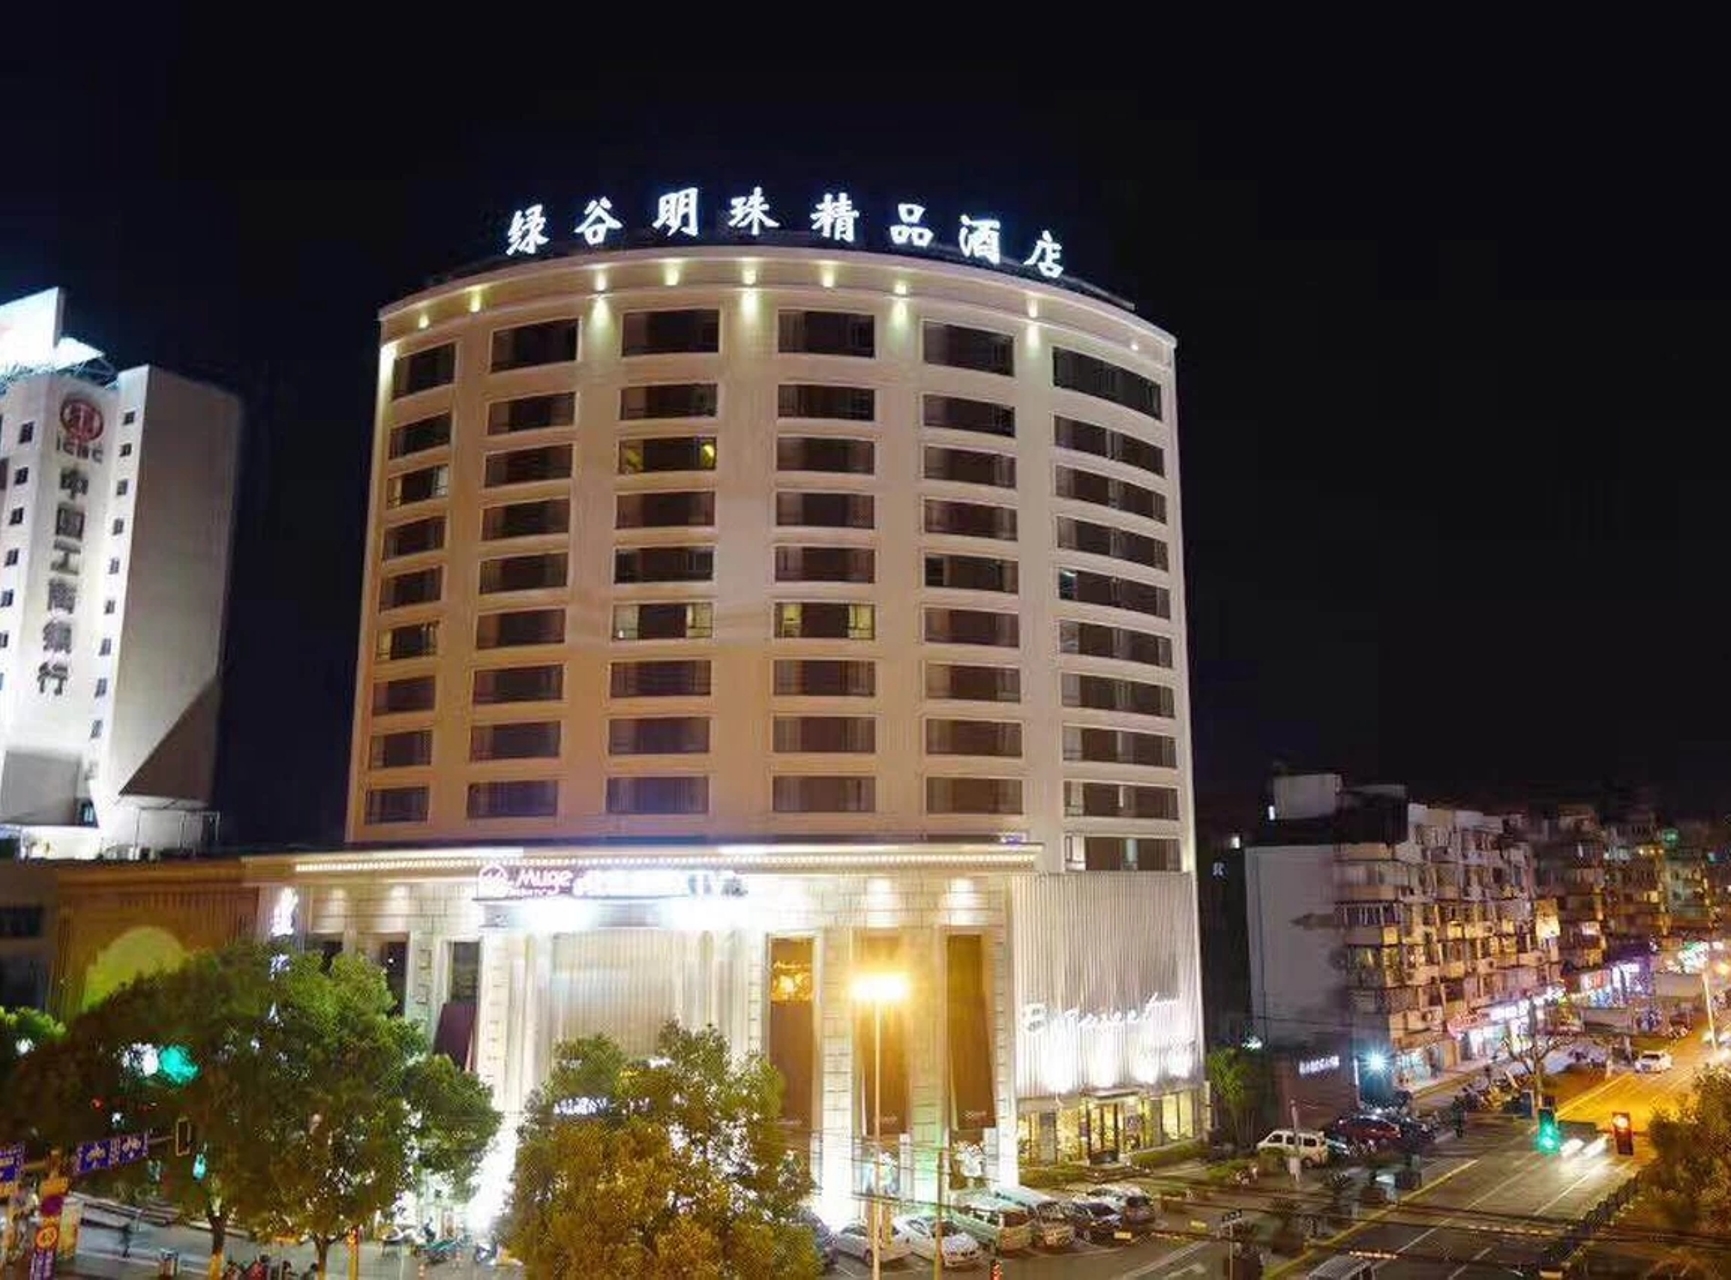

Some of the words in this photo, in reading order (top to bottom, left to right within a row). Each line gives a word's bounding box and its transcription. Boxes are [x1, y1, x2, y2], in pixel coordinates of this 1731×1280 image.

[506, 187, 1064, 277] 绿谷明珠精品酒店
[37, 465, 89, 696] 中国工商银行
